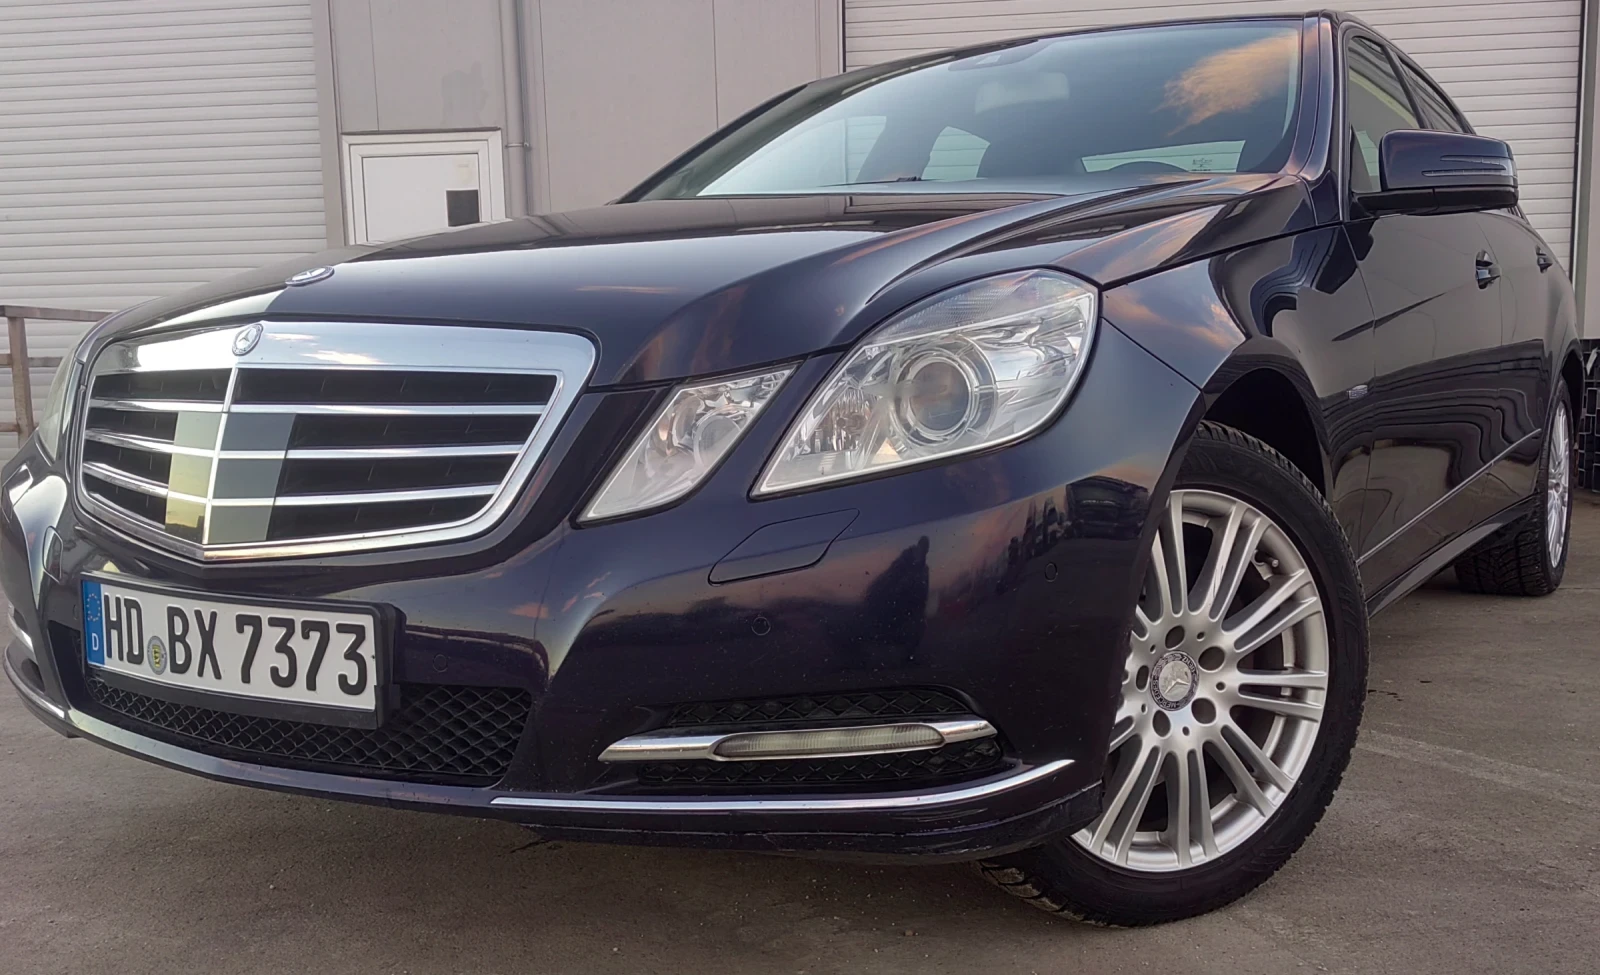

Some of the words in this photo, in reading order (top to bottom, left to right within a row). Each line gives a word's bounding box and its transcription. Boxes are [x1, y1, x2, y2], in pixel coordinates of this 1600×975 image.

[92, 633, 99, 651] D
[104, 594, 144, 665] HD
[166, 605, 222, 680] BX
[235, 613, 367, 696] 7373
